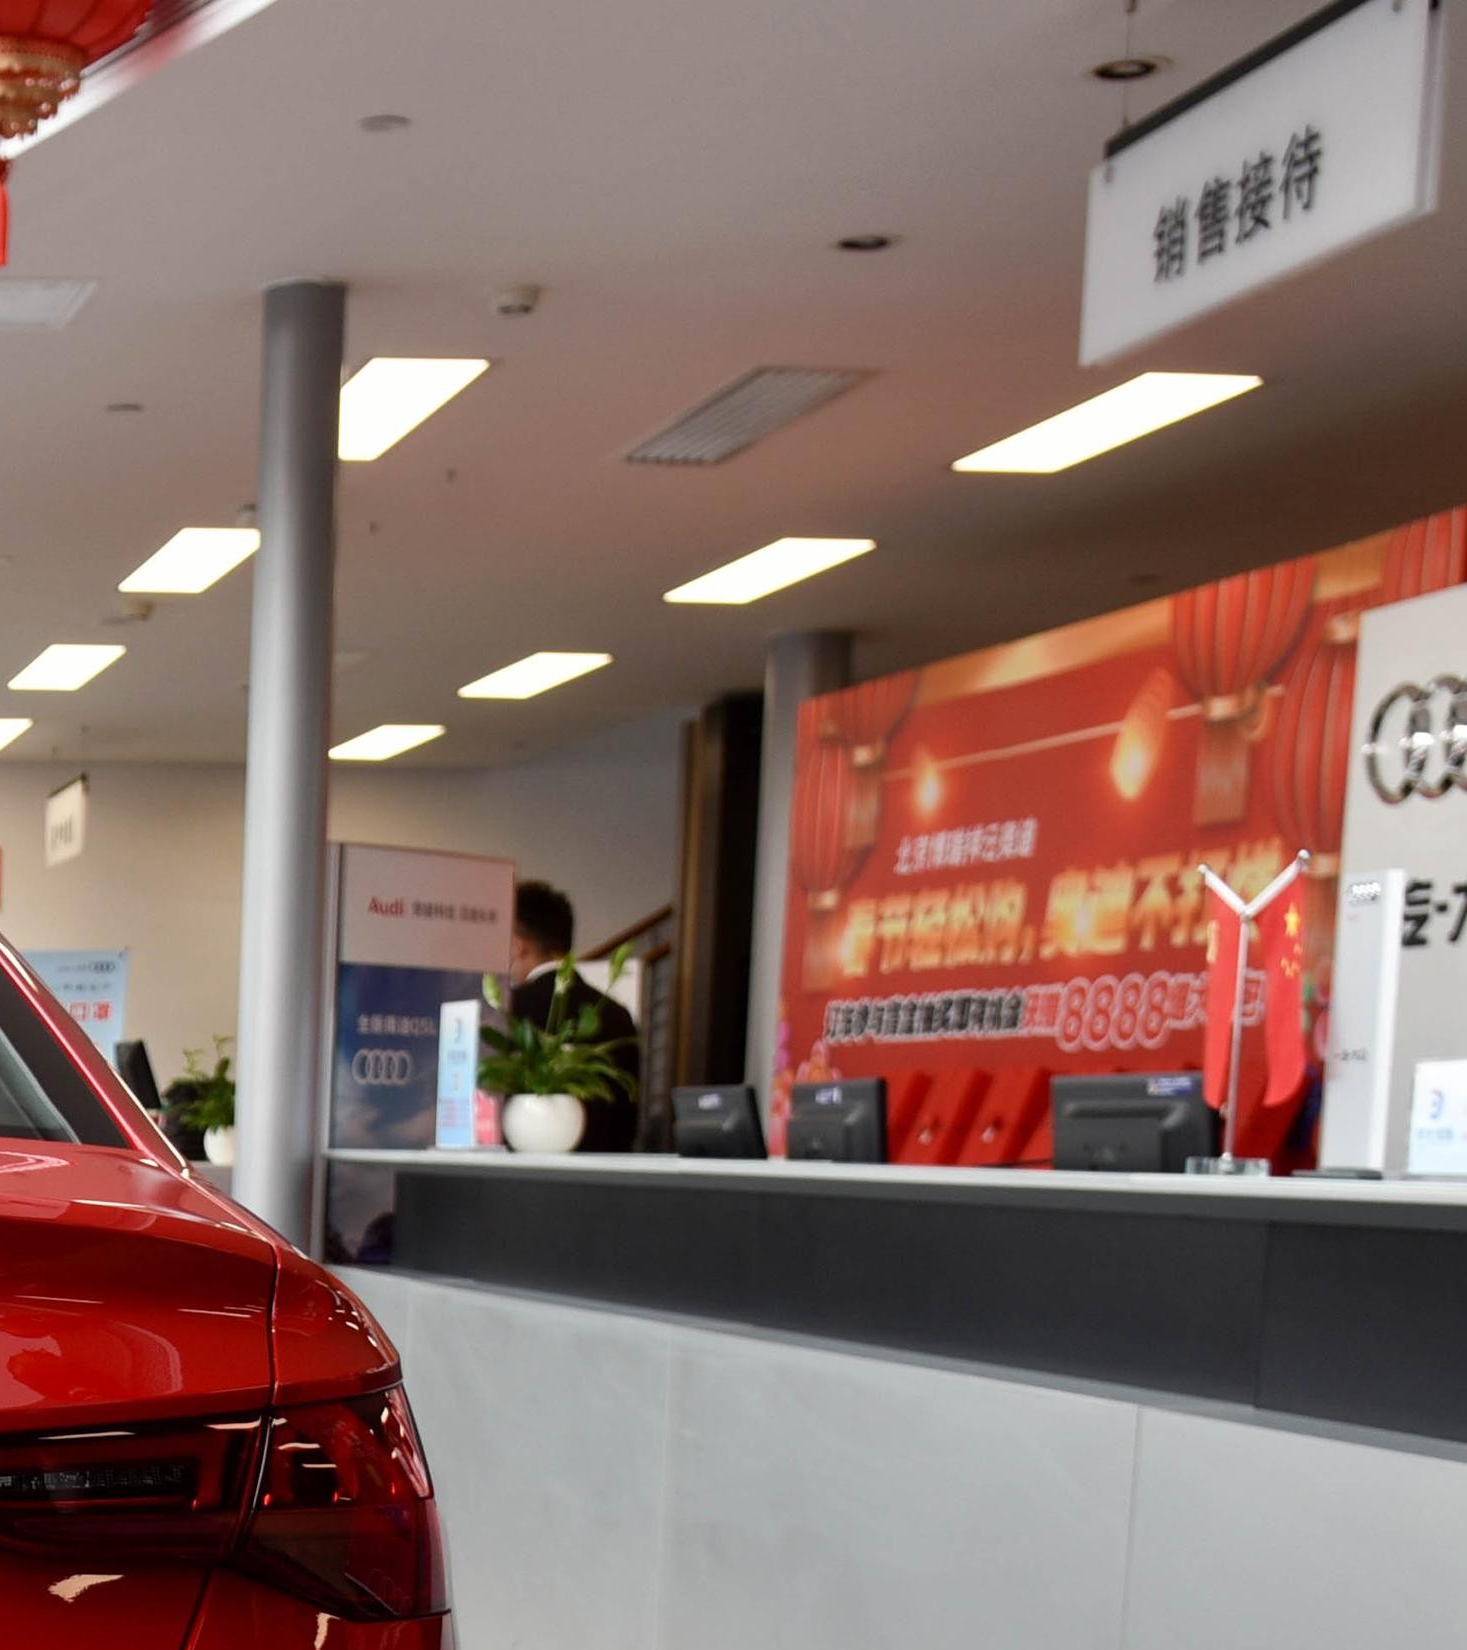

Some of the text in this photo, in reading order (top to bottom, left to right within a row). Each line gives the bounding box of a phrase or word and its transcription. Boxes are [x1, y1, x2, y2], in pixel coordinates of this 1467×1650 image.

[1153, 123, 1323, 283] 销售接待
[369, 897, 405, 917] Audi
